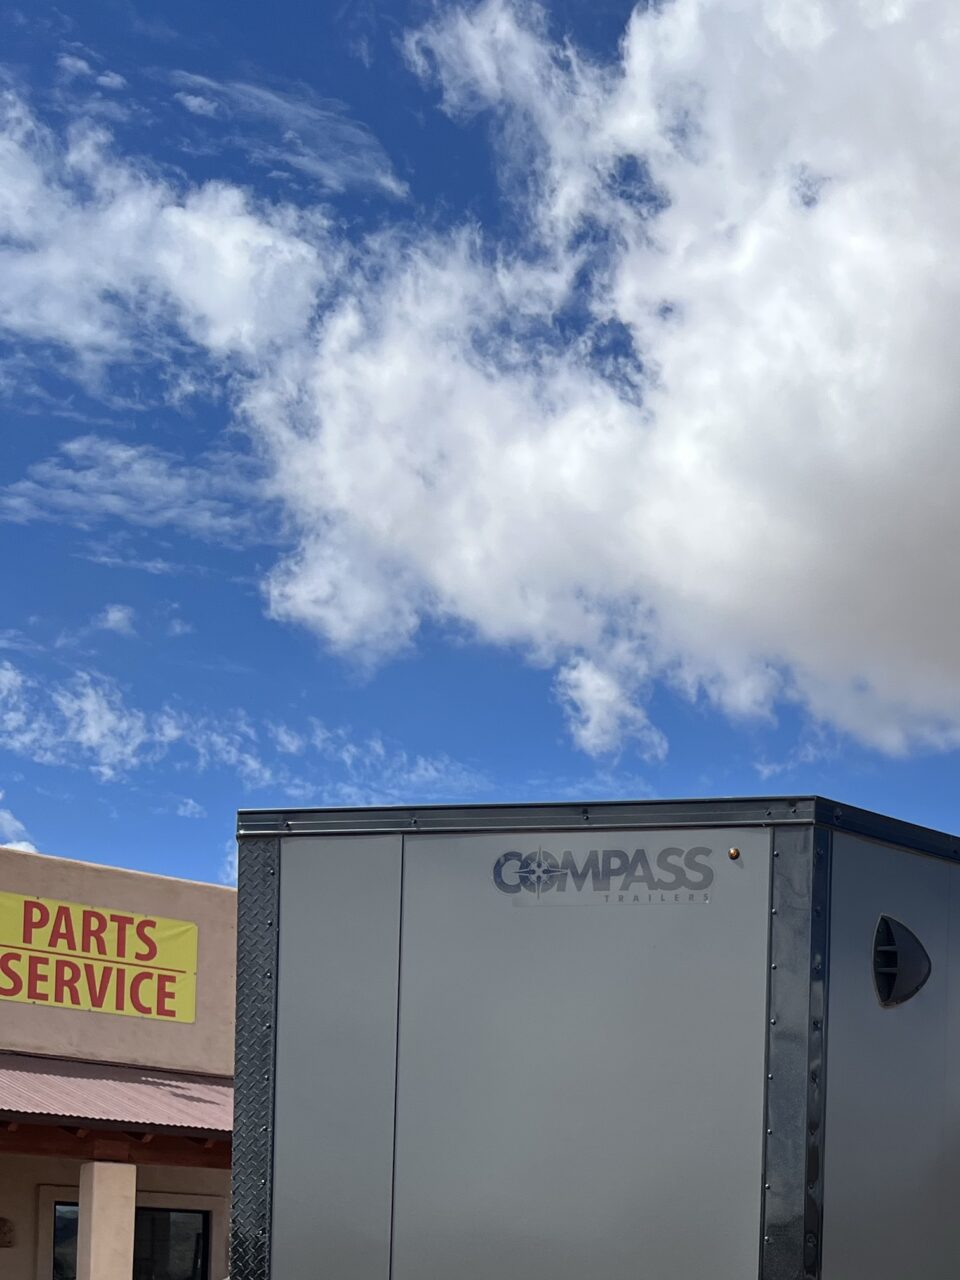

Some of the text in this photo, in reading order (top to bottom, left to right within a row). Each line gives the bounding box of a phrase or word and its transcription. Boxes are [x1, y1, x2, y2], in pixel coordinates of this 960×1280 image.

[493, 846, 714, 895] COMPASS
[605, 893, 709, 903] TRAILERS
[22, 900, 157, 961] PARTS
[0, 952, 176, 1017] SERVICE
